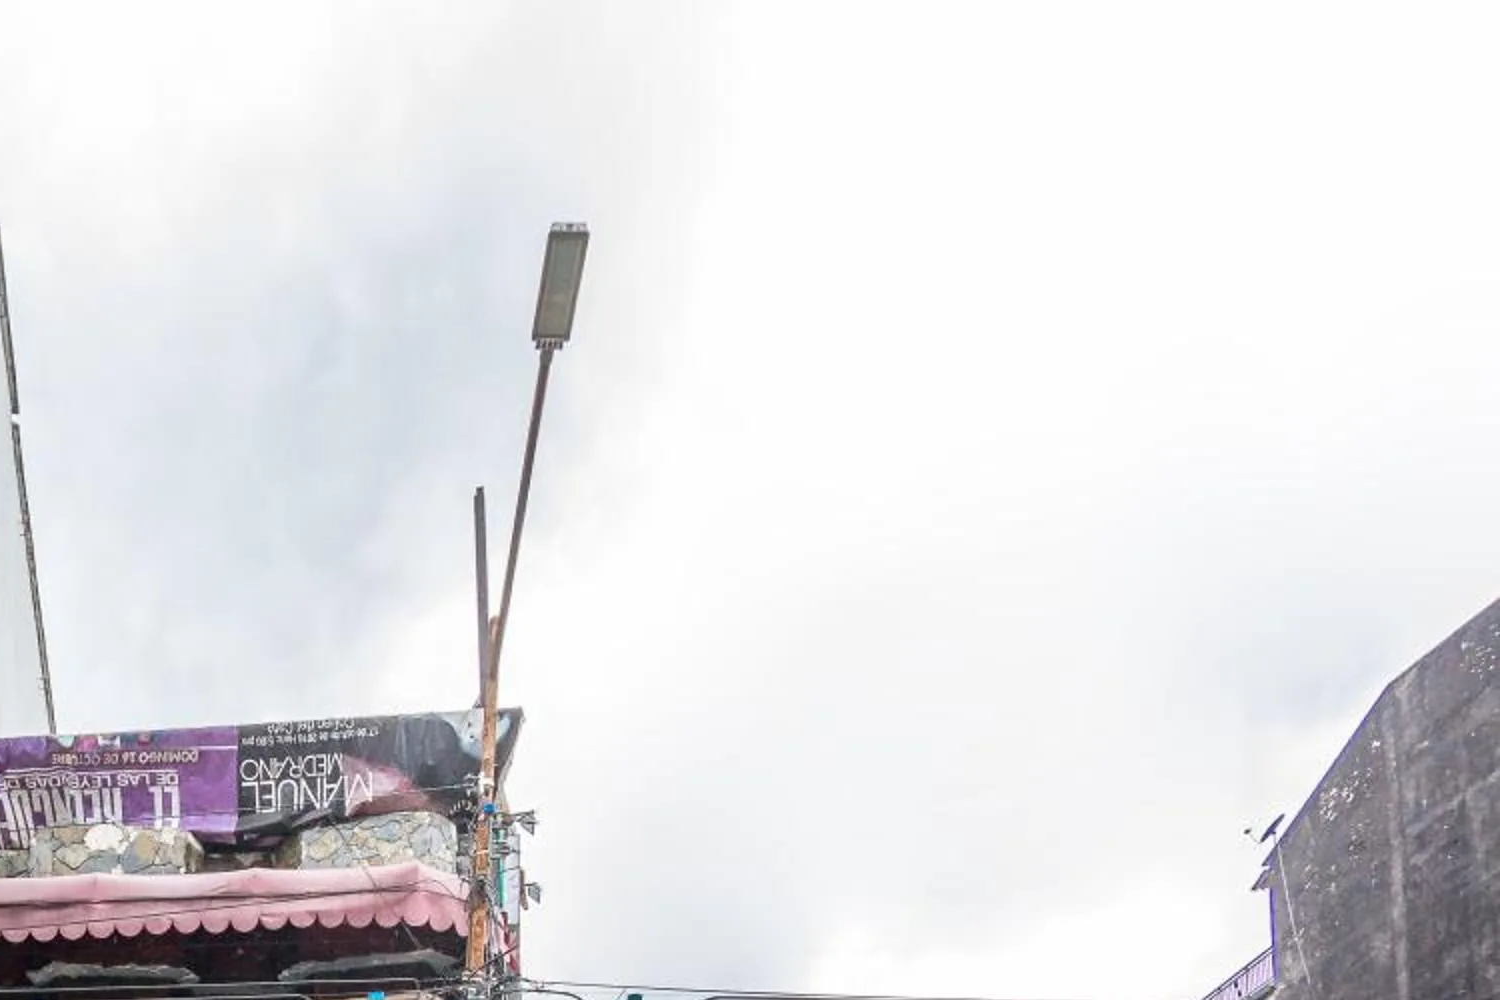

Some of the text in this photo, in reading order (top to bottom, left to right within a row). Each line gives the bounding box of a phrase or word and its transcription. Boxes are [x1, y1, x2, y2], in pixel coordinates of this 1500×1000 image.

[103, 751, 119, 763] DE
[139, 750, 199, 765] DOMINGO
[241, 752, 343, 780] MEDRANO
[117, 773, 150, 787] LAS
[155, 773, 179, 785] DE
[242, 769, 372, 816] MANUEL
